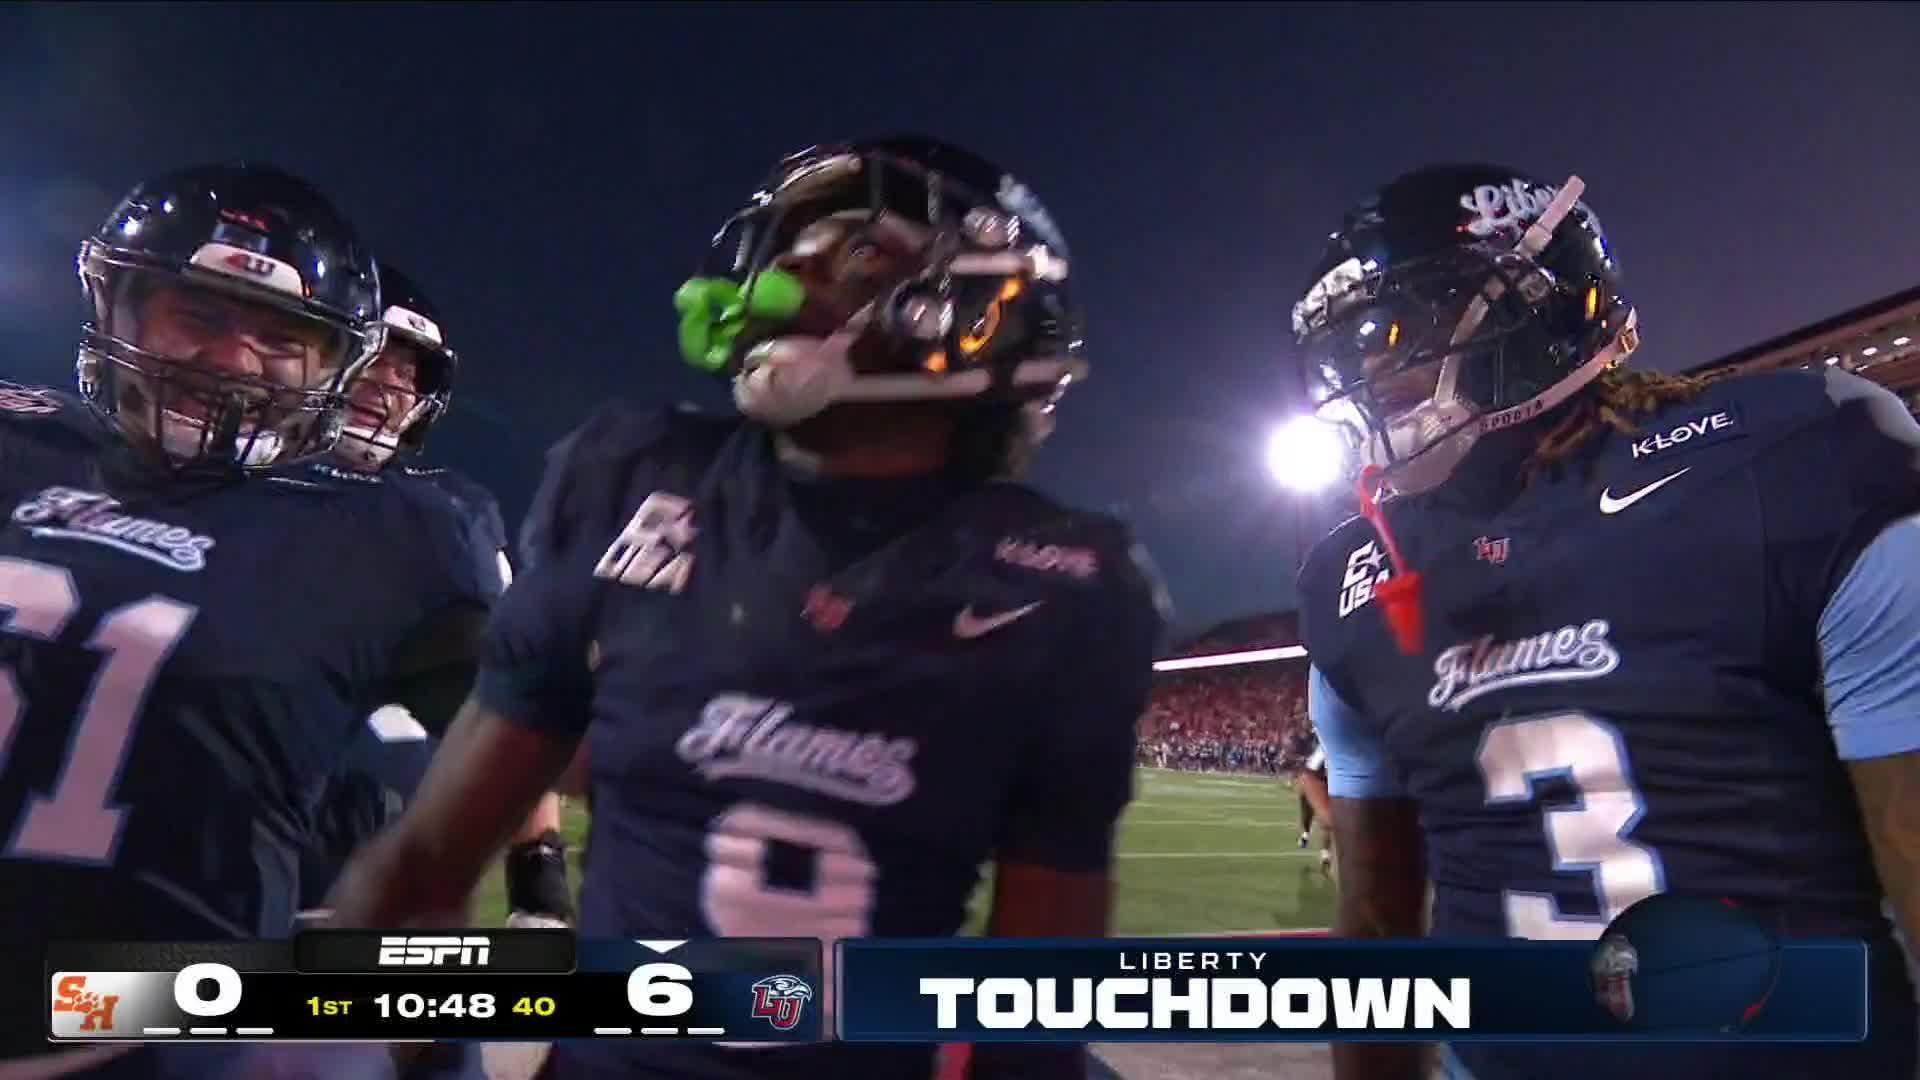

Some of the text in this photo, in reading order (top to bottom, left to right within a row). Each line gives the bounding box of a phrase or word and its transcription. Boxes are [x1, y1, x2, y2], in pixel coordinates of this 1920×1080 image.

[11, 486, 216, 567] Flames
[1428, 619, 1620, 711] Flames
[675, 692, 918, 806] Flames
[1474, 709, 1667, 942] 3
